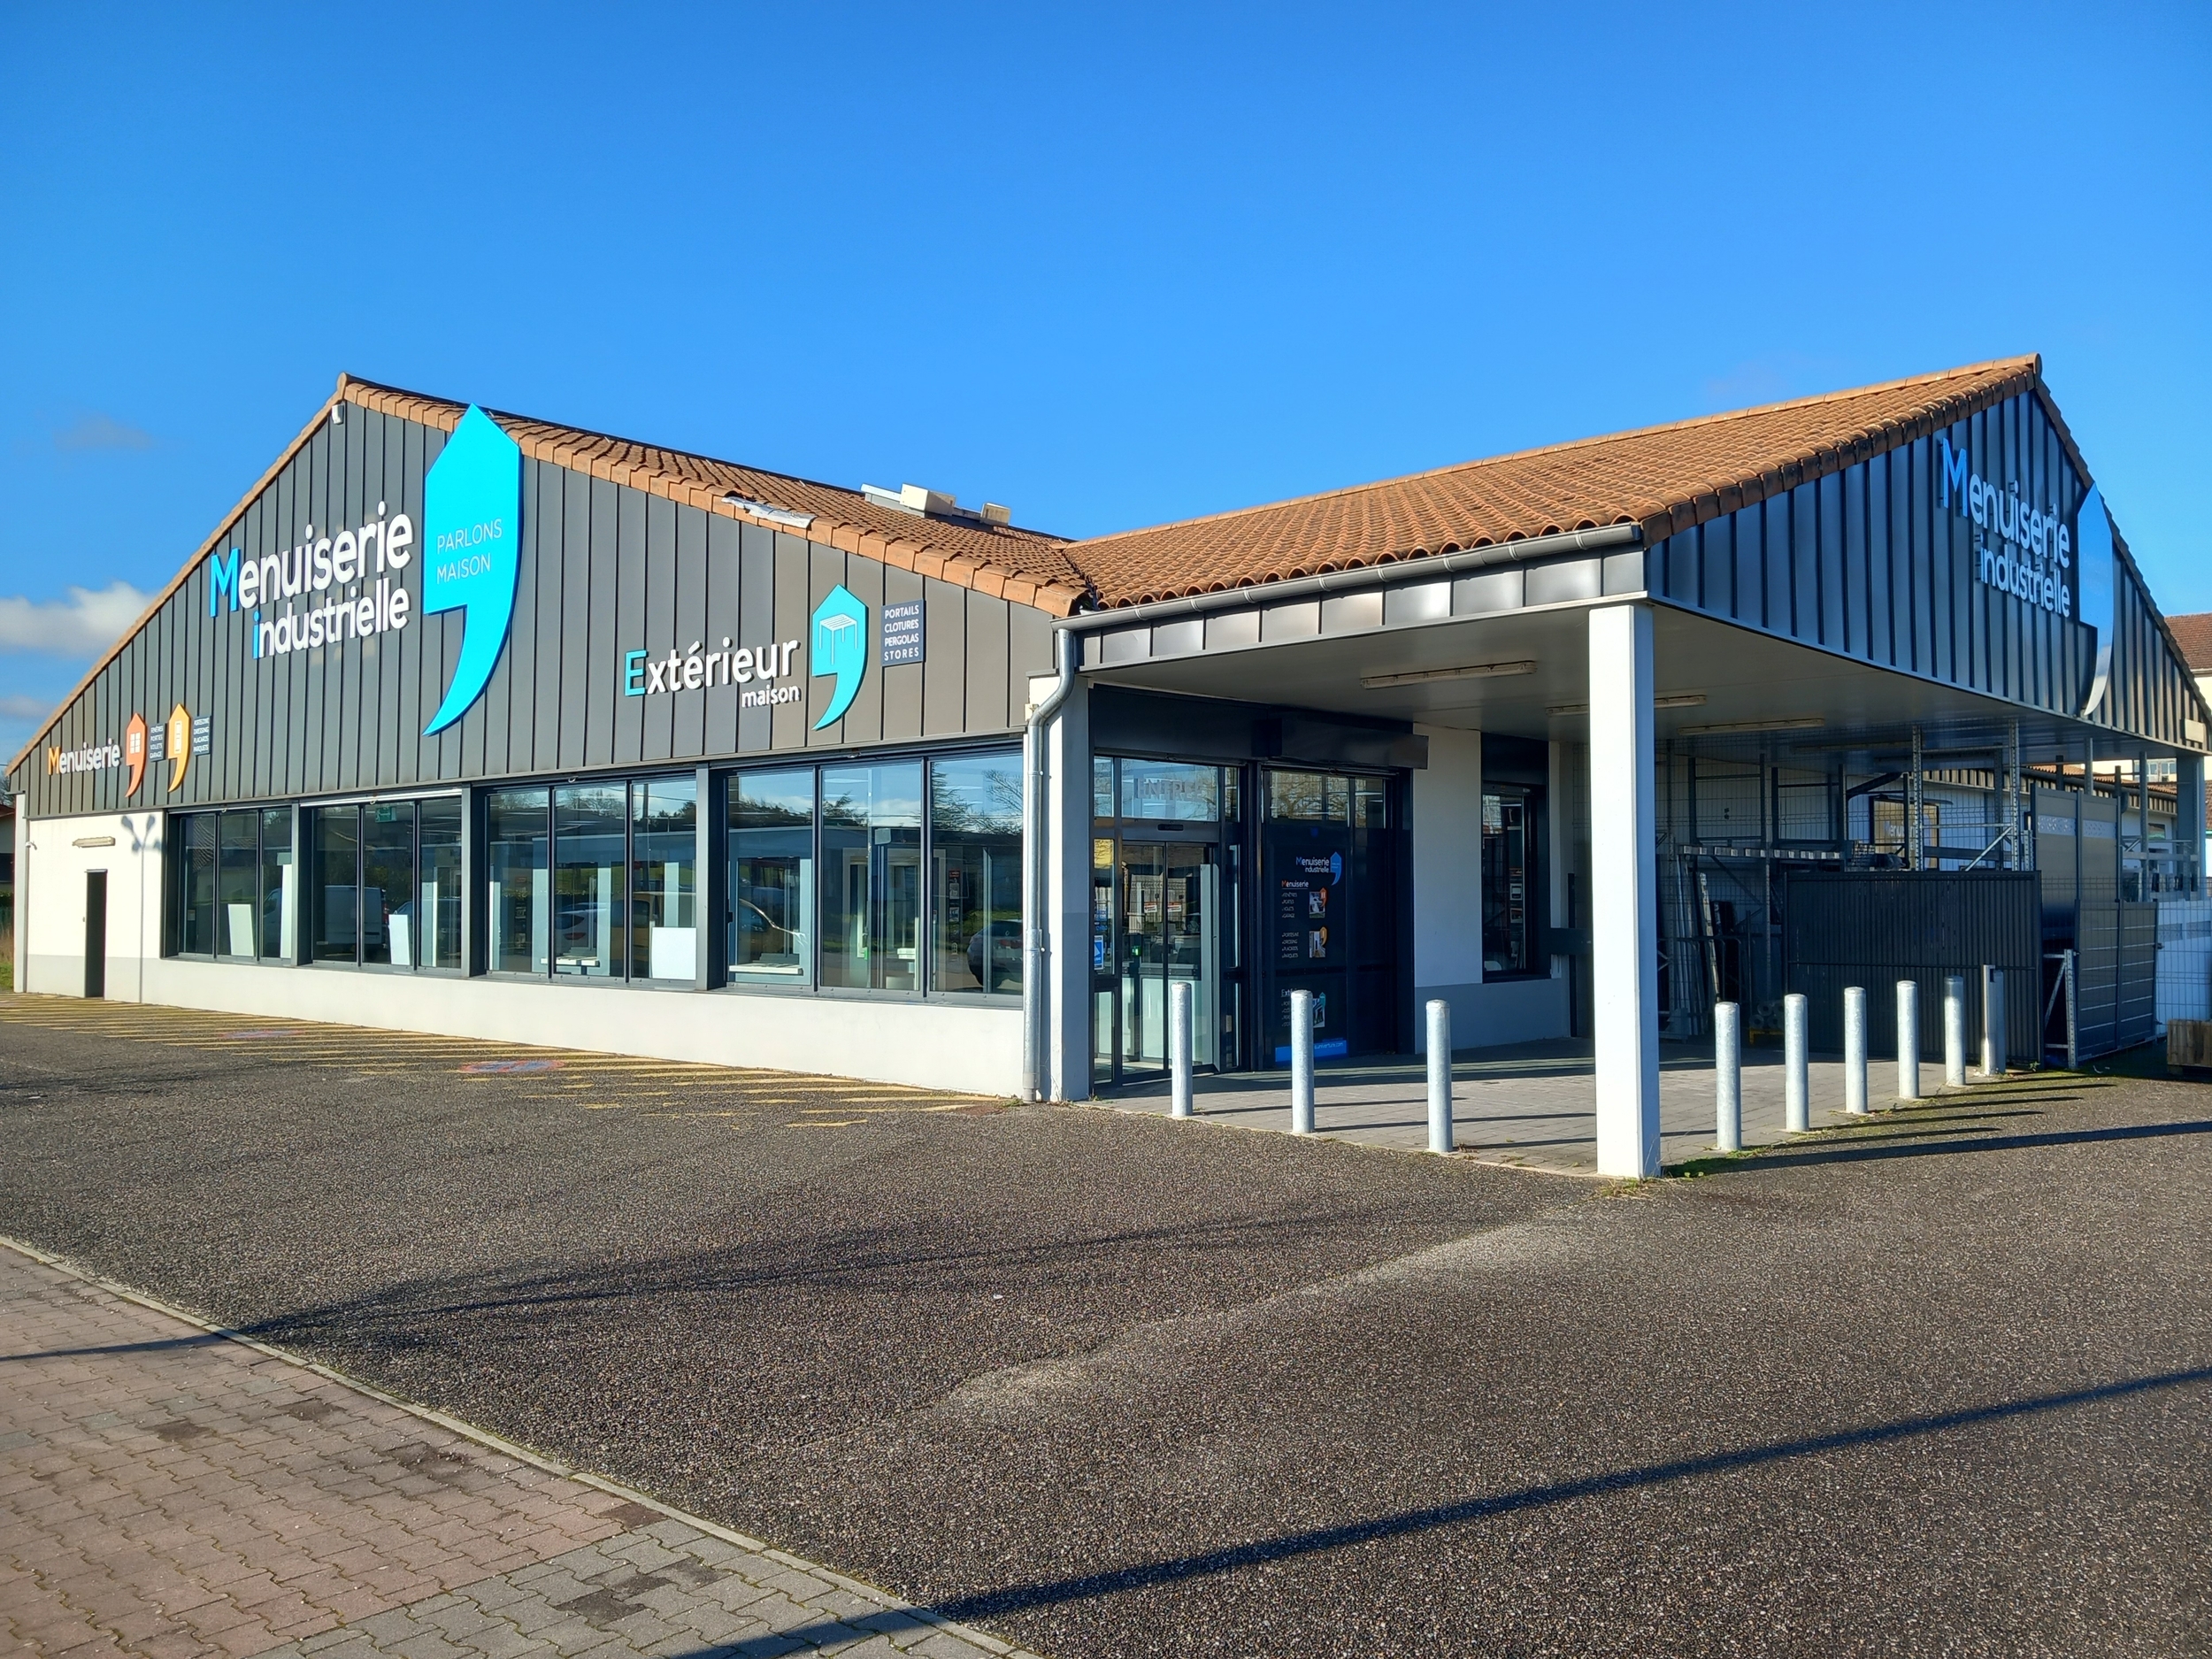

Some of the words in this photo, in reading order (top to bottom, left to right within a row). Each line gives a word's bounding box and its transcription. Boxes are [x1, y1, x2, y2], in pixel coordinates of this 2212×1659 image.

[1942, 437, 2070, 568] Menuiserie
[437, 518, 503, 555] PARLONS
[209, 501, 414, 618] Menuiserie
[436, 552, 491, 585] MAISON
[1979, 533, 2070, 618] industrielle
[252, 577, 411, 659] industrielle
[884, 619, 919, 634] CLOTURES
[885, 605, 919, 619] PORTAILS
[884, 647, 919, 661] STORES
[885, 634, 919, 647] PERGOLAS
[625, 637, 799, 696] Extérieur
[741, 685, 800, 707] maison
[48, 737, 120, 775] Menuiserie
[1296, 856, 1330, 866] Menuiserie
